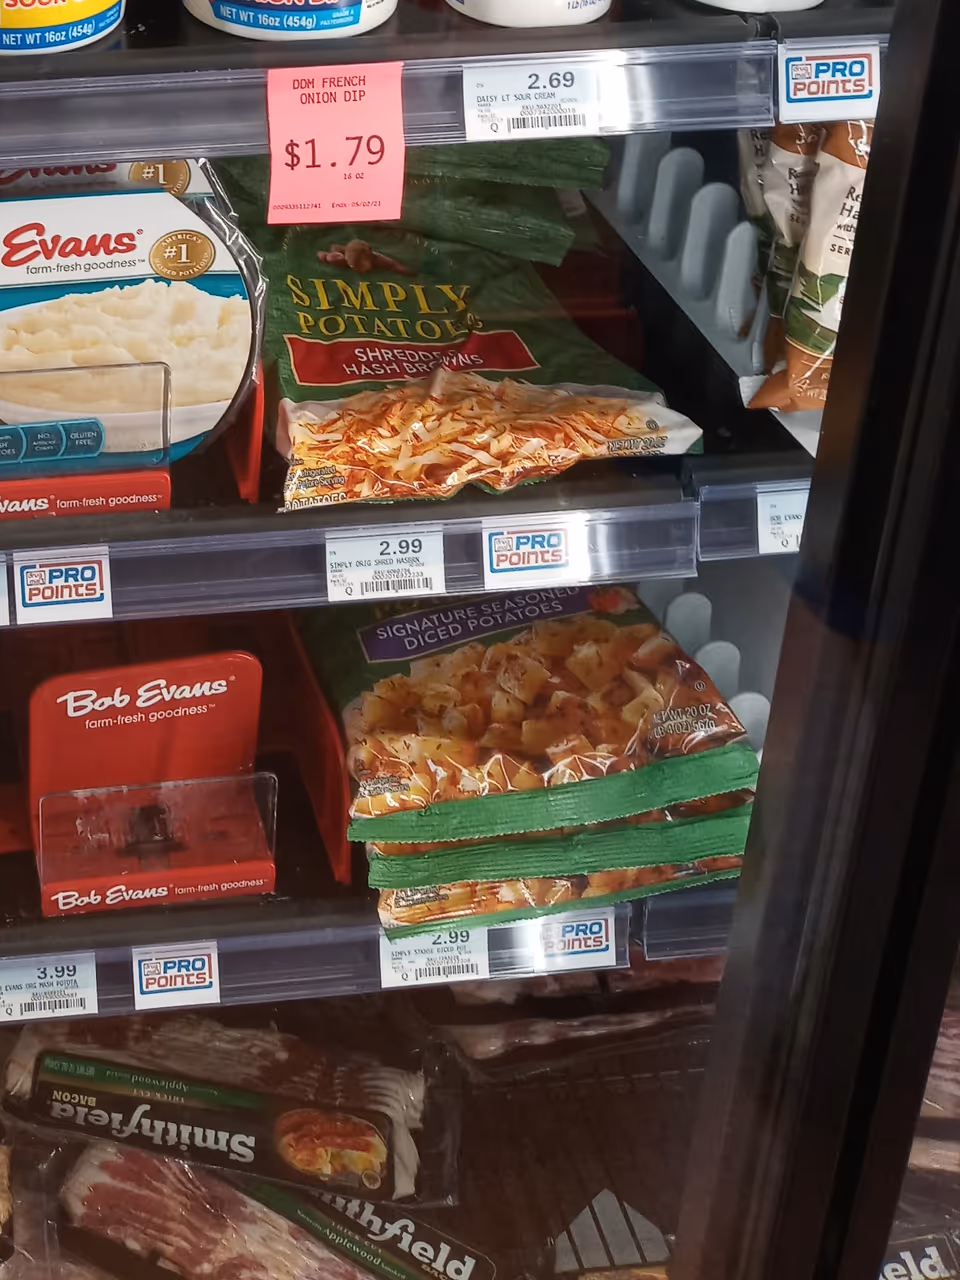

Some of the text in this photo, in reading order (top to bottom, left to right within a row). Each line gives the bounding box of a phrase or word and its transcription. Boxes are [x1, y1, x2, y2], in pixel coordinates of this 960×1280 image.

[814, 61, 865, 79] PRO
[293, 75, 366, 91] DDM FRENCH
[527, 71, 576, 90] 2.69
[793, 78, 866, 96] POINTS
[300, 90, 366, 105] ONION DIP
[476, 92, 556, 104] DAISY LT SOUR CREAM
[284, 134, 385, 171] $1.79
[2, 222, 137, 269] Evans
[26, 262, 82, 276] farm-fresh
[287, 273, 473, 314] SIMPLY
[343, 361, 401, 377] HASH
[379, 538, 423, 556] 2.99
[376, 606, 478, 641] SIGNATURE
[403, 600, 563, 650] DICED POTATOES
[56, 678, 228, 718] Bob Evans
[85, 711, 145, 729] farm-fresh
[36, 963, 77, 980] 3.99
[132, 1072, 189, 1092] Applewood
[52, 1089, 97, 1107] BACON
[50, 1101, 257, 1163] Smithfield
